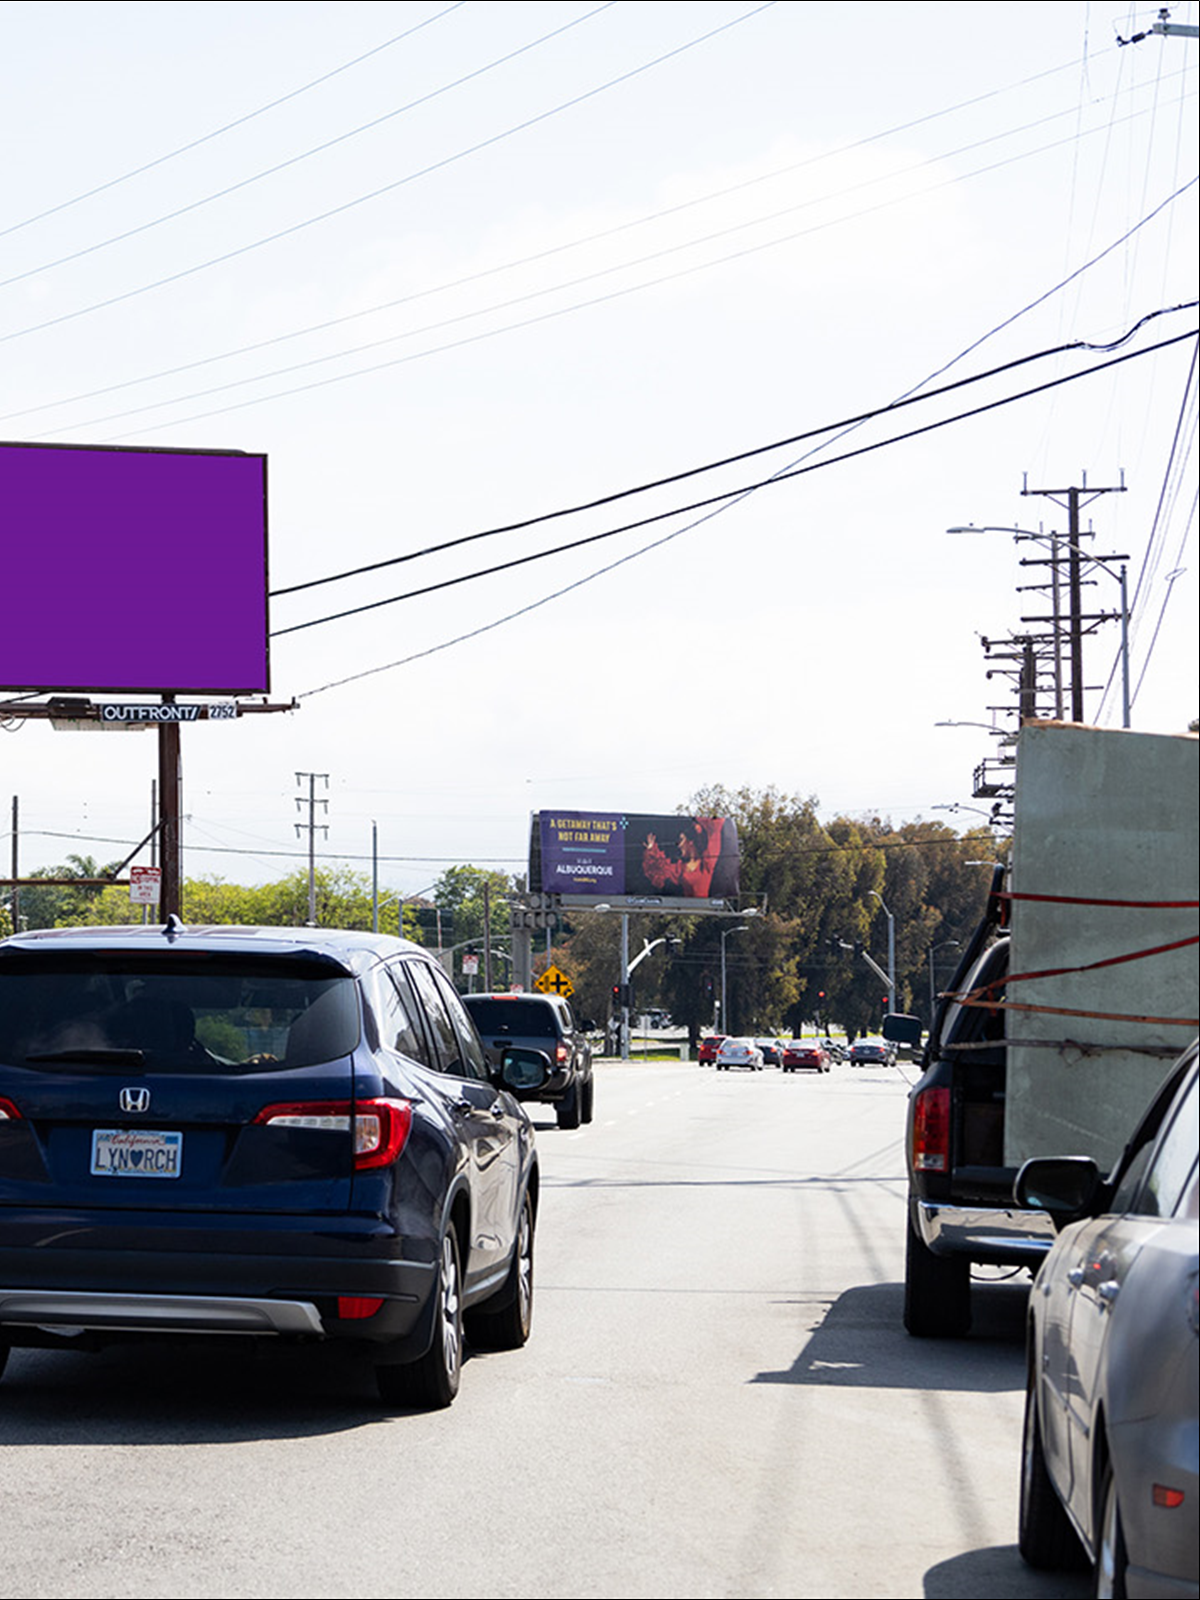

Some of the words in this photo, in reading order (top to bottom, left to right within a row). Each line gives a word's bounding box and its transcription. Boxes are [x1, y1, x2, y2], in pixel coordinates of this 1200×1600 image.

[210, 704, 236, 719] 2752
[550, 818, 556, 828] A
[557, 818, 591, 830] GETAWAY
[593, 820, 617, 831] THAT'S
[558, 831, 573, 842] NOT
[575, 831, 589, 842] FAR
[590, 832, 611, 843] AWAY
[556, 864, 613, 876] ALBUQUERQUE
[111, 1133, 165, 1148] California
